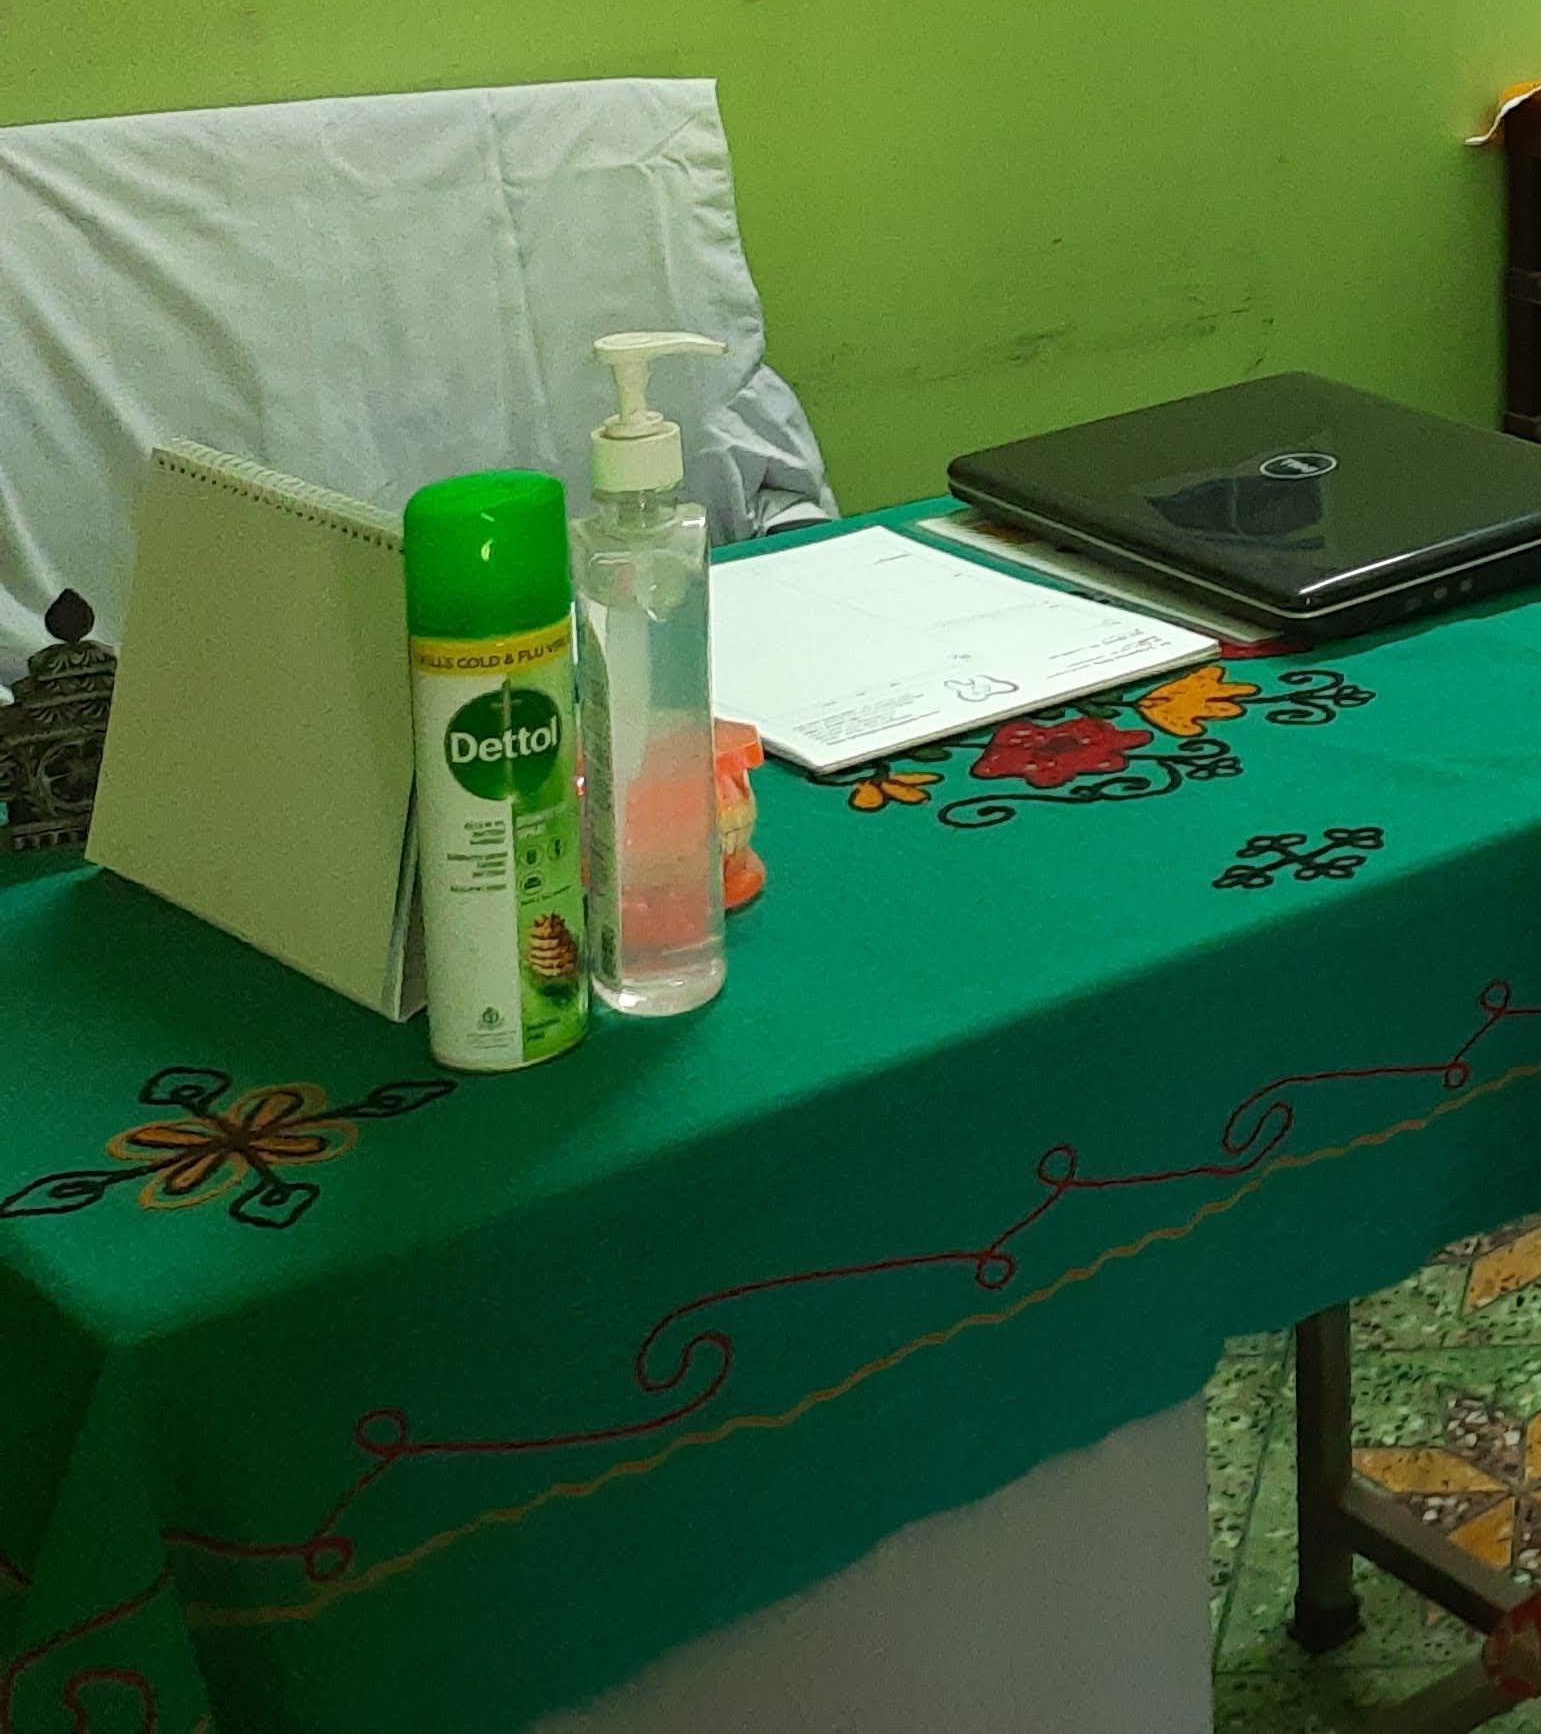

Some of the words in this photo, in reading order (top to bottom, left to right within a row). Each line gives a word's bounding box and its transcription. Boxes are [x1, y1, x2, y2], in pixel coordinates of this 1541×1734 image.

[457, 655, 499, 669] COLD
[500, 654, 514, 665] &
[517, 647, 544, 663] FLU
[450, 715, 557, 764] Dettol
